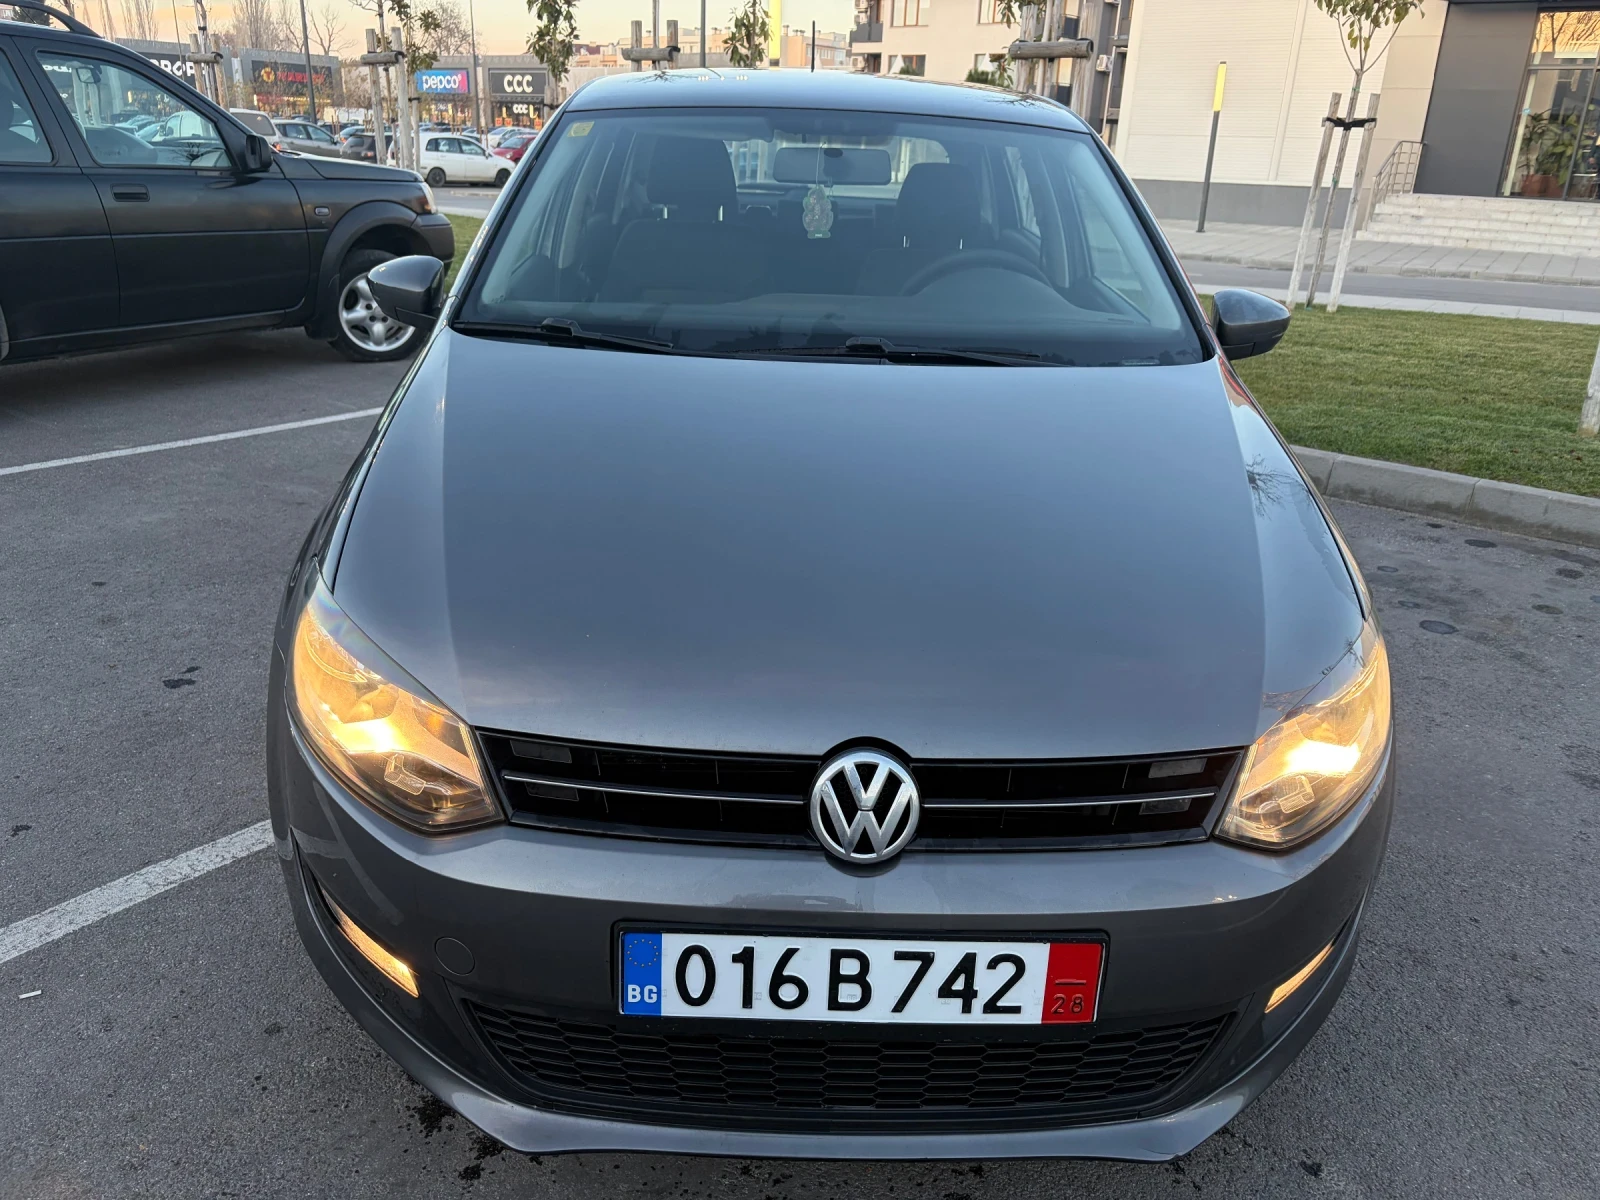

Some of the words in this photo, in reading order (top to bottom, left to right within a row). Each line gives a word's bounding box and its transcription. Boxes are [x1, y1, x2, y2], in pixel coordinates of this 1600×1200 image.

[503, 74, 533, 93] CCC
[512, 103, 528, 114] CCC
[627, 984, 658, 1004] BG
[1050, 993, 1085, 1014] 28
